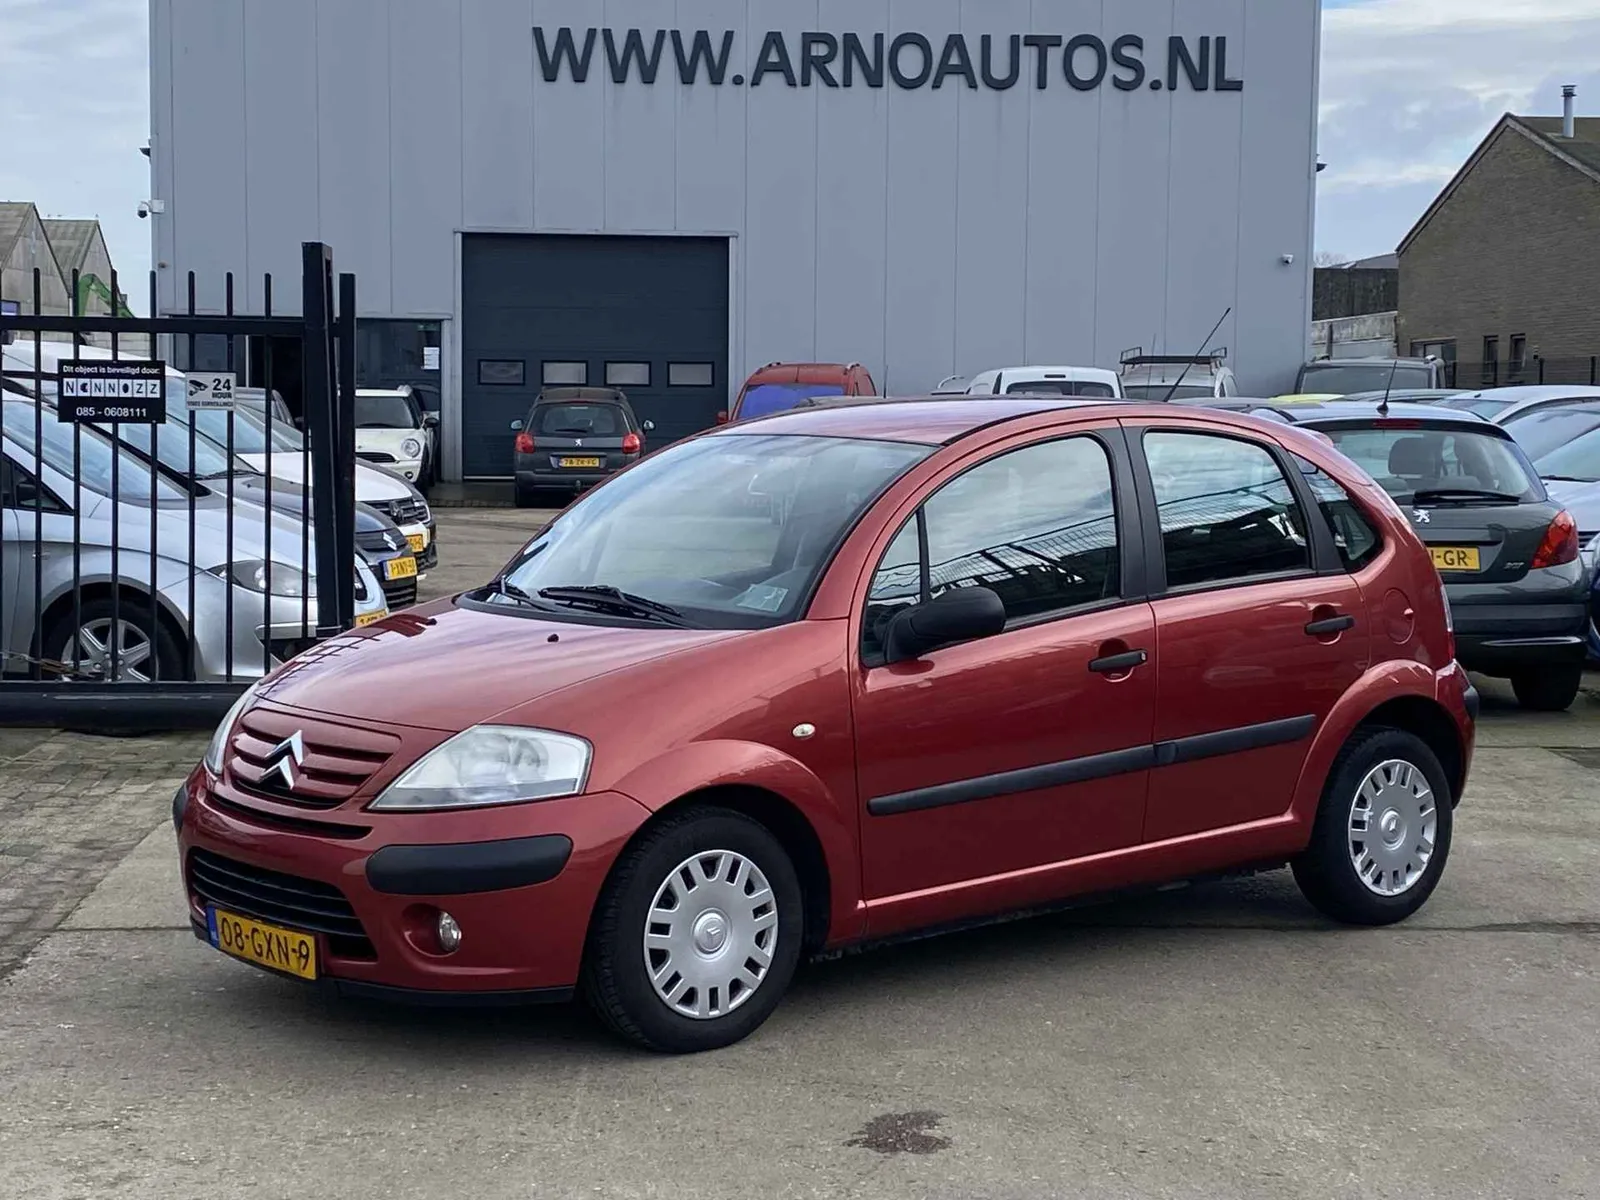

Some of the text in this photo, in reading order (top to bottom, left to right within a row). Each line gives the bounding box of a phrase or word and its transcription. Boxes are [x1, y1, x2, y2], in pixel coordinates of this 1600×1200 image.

[532, 27, 1243, 91] WWW.ARNOAUTOS.NL
[63, 365, 74, 373] Dit
[75, 366, 98, 375] object
[212, 378, 232, 391] 24
[76, 407, 95, 416] 085
[104, 407, 147, 417] 0608111
[221, 917, 310, 972] 08-GXN-9
